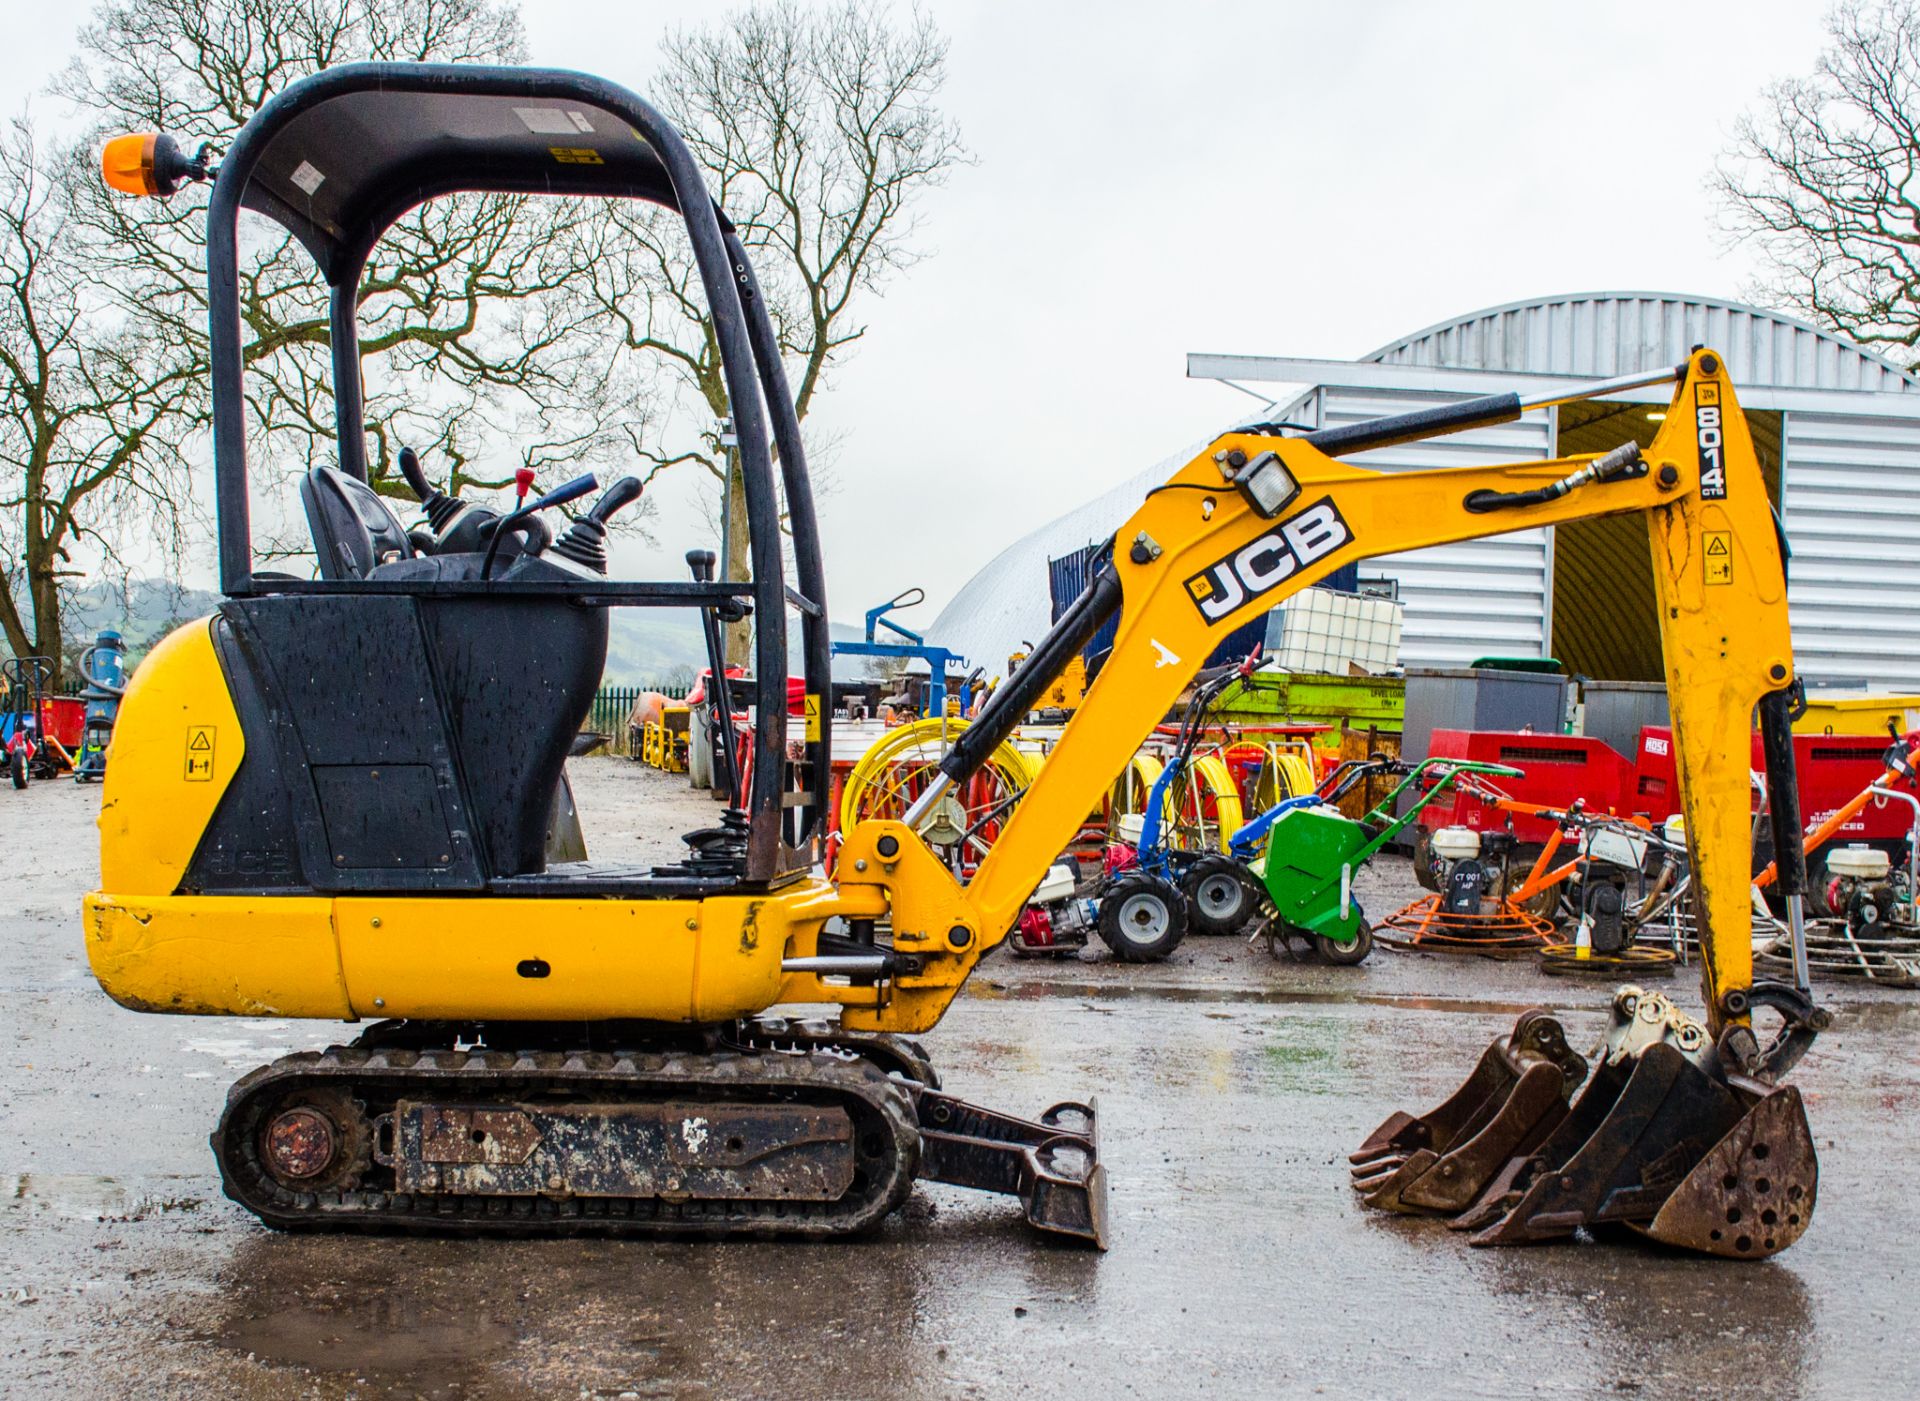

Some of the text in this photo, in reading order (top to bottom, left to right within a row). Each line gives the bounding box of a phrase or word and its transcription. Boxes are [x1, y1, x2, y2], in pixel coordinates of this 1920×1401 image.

[1697, 407, 1725, 488] 8014
[1201, 504, 1347, 619] JCB
[1455, 873, 1480, 881] CT 901
